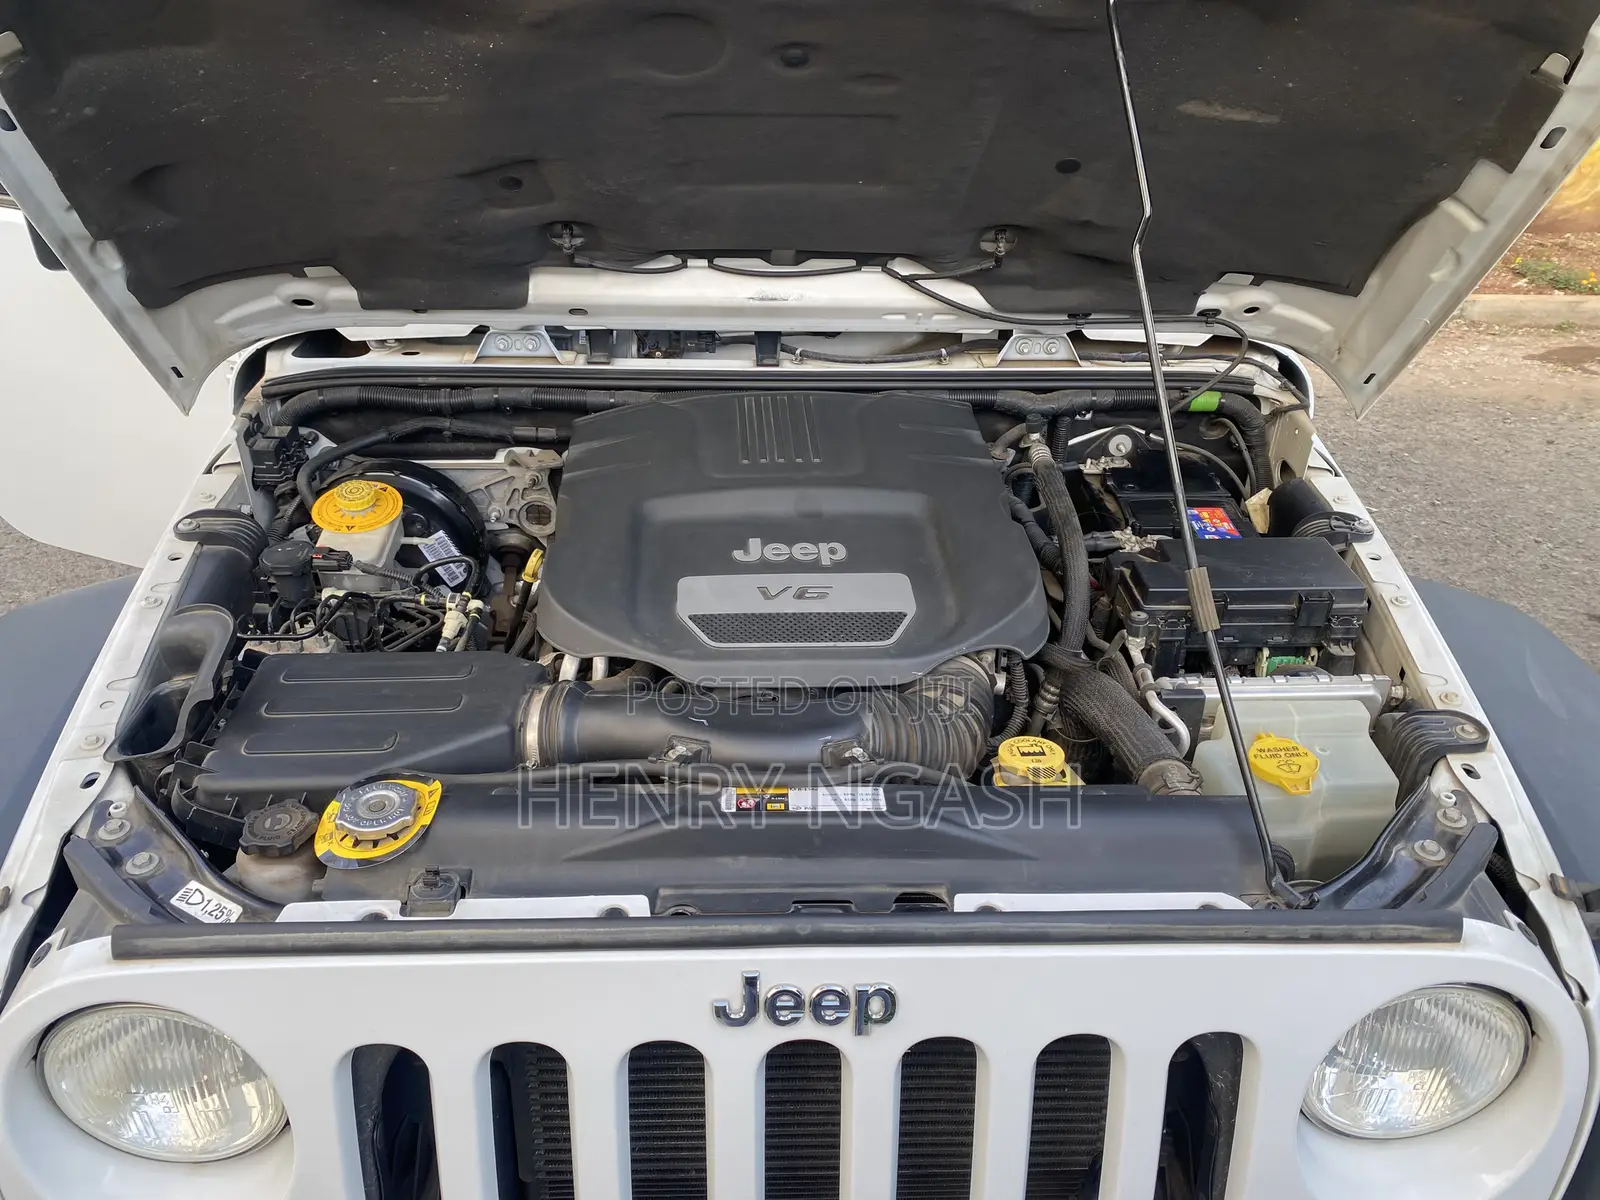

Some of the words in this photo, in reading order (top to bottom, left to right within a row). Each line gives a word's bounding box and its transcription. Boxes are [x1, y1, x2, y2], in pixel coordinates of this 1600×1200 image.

[732, 537, 847, 567] Jeep
[757, 585, 833, 600] V6
[713, 969, 898, 1037] Jeep
